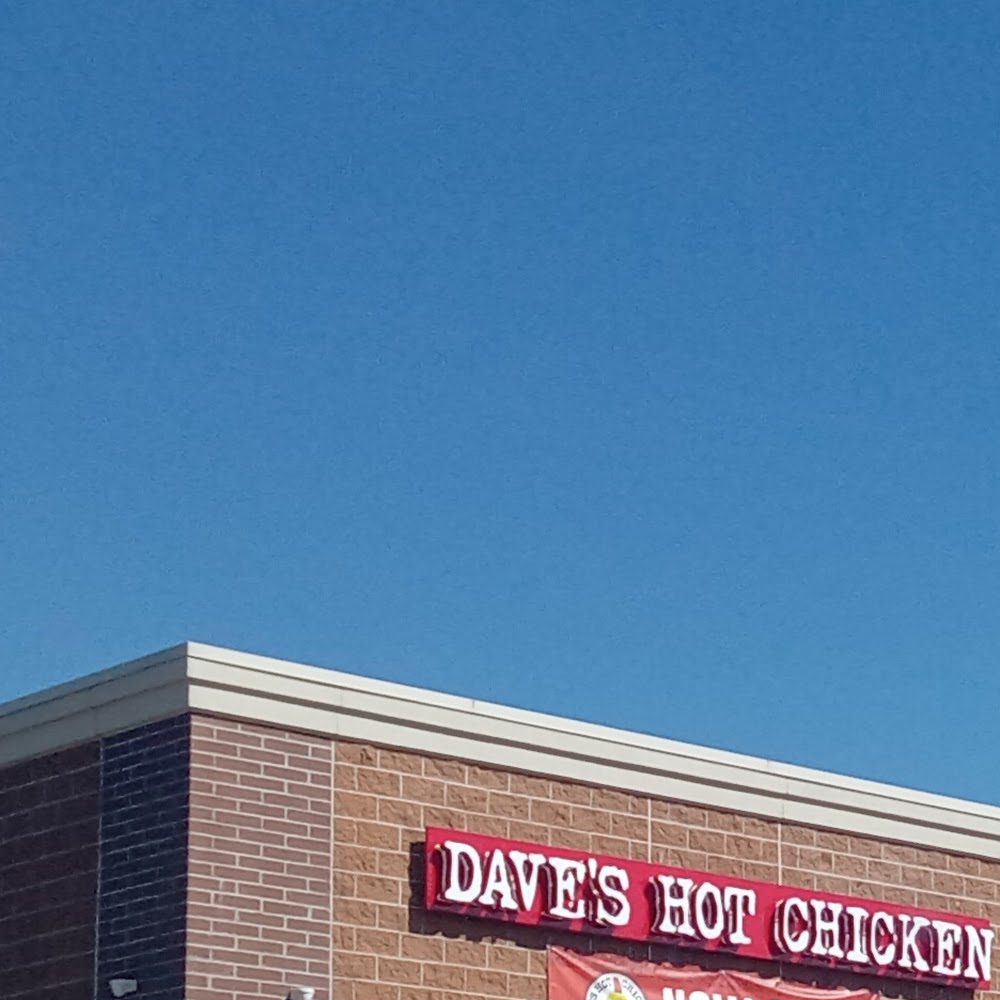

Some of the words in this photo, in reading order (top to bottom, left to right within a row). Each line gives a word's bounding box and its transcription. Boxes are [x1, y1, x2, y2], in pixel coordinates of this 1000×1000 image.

[444, 840, 631, 926] DAVE'S
[654, 875, 756, 944] HOT
[782, 898, 994, 980] CHICKEN
